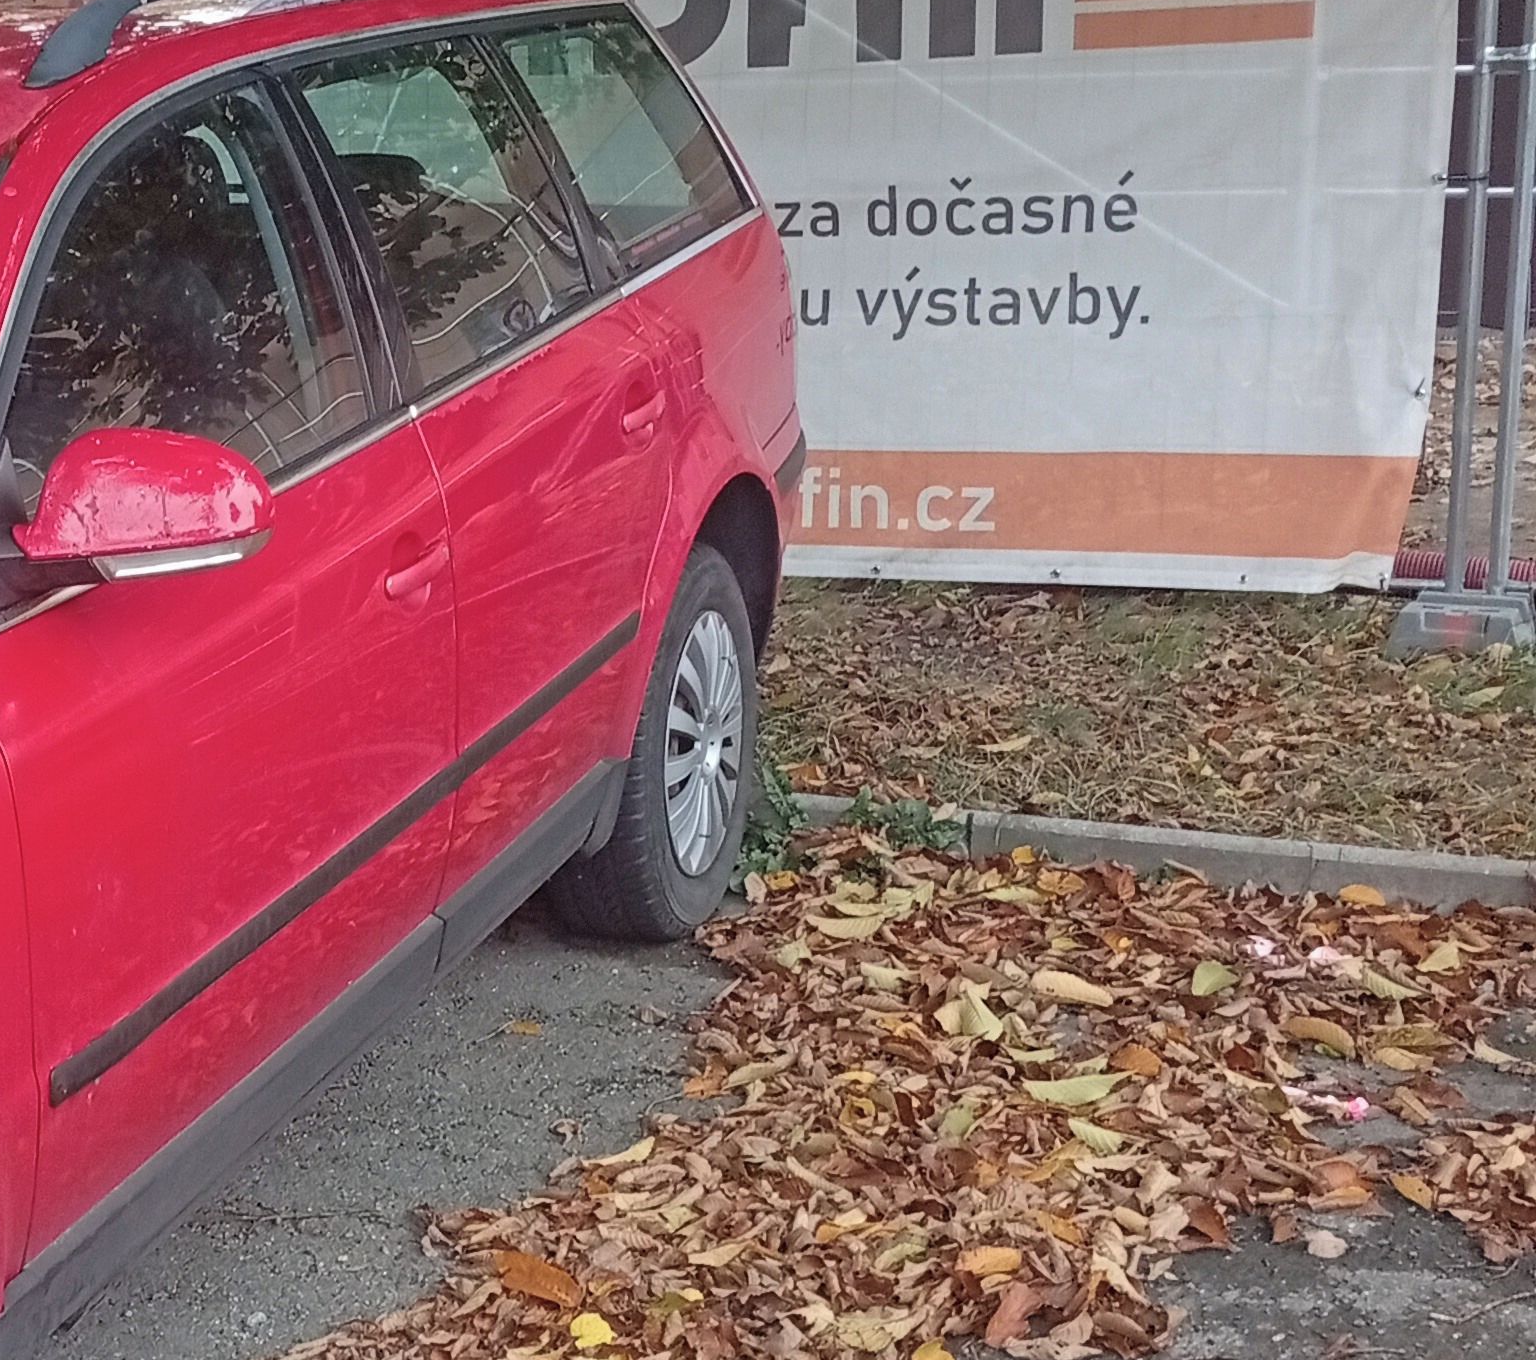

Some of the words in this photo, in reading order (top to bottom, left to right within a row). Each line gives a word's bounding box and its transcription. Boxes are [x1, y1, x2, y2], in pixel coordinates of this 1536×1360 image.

[774, 199, 841, 237] za
[866, 169, 1139, 237] dočasné
[855, 265, 1151, 341] výstavby.
[798, 466, 996, 532] fin.cz
